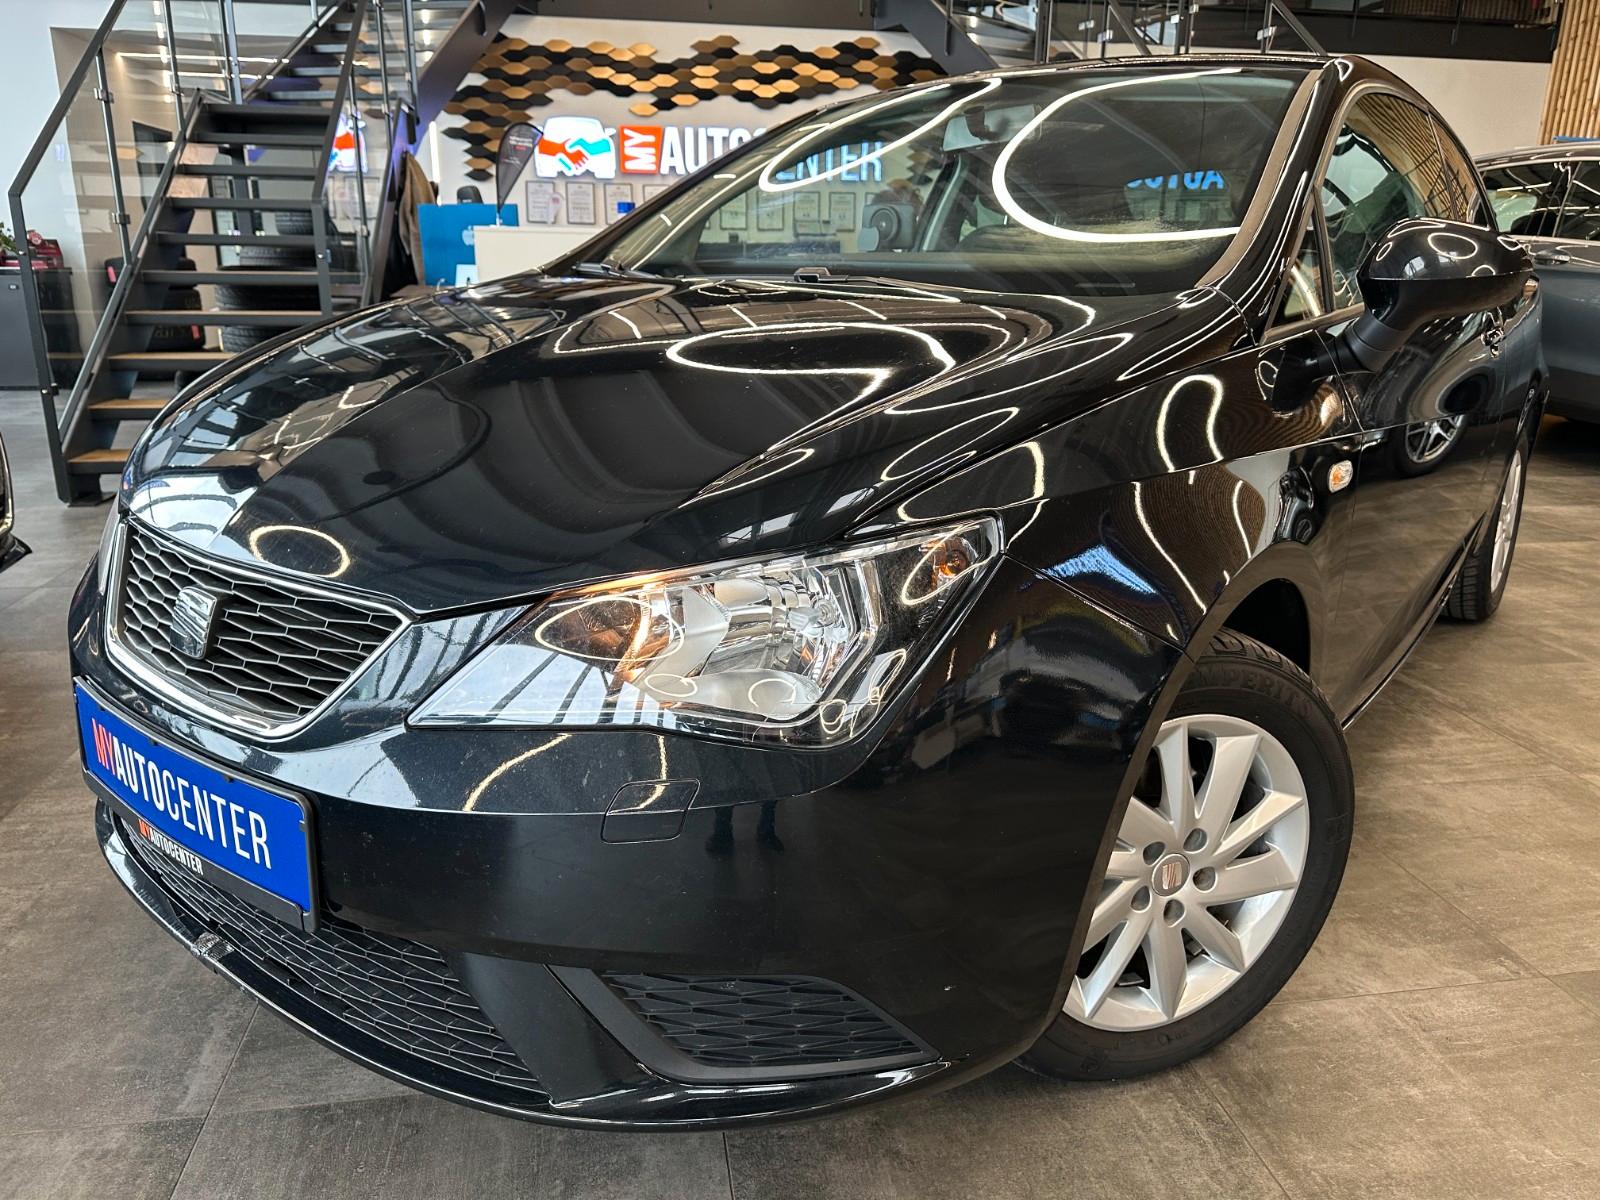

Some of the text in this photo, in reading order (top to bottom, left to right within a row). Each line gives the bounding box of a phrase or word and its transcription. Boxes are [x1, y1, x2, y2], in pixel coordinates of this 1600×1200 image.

[623, 129, 657, 170] MY
[91, 717, 272, 870] MYAUTOCENTER
[138, 818, 204, 876] MYAUTOCENTER
